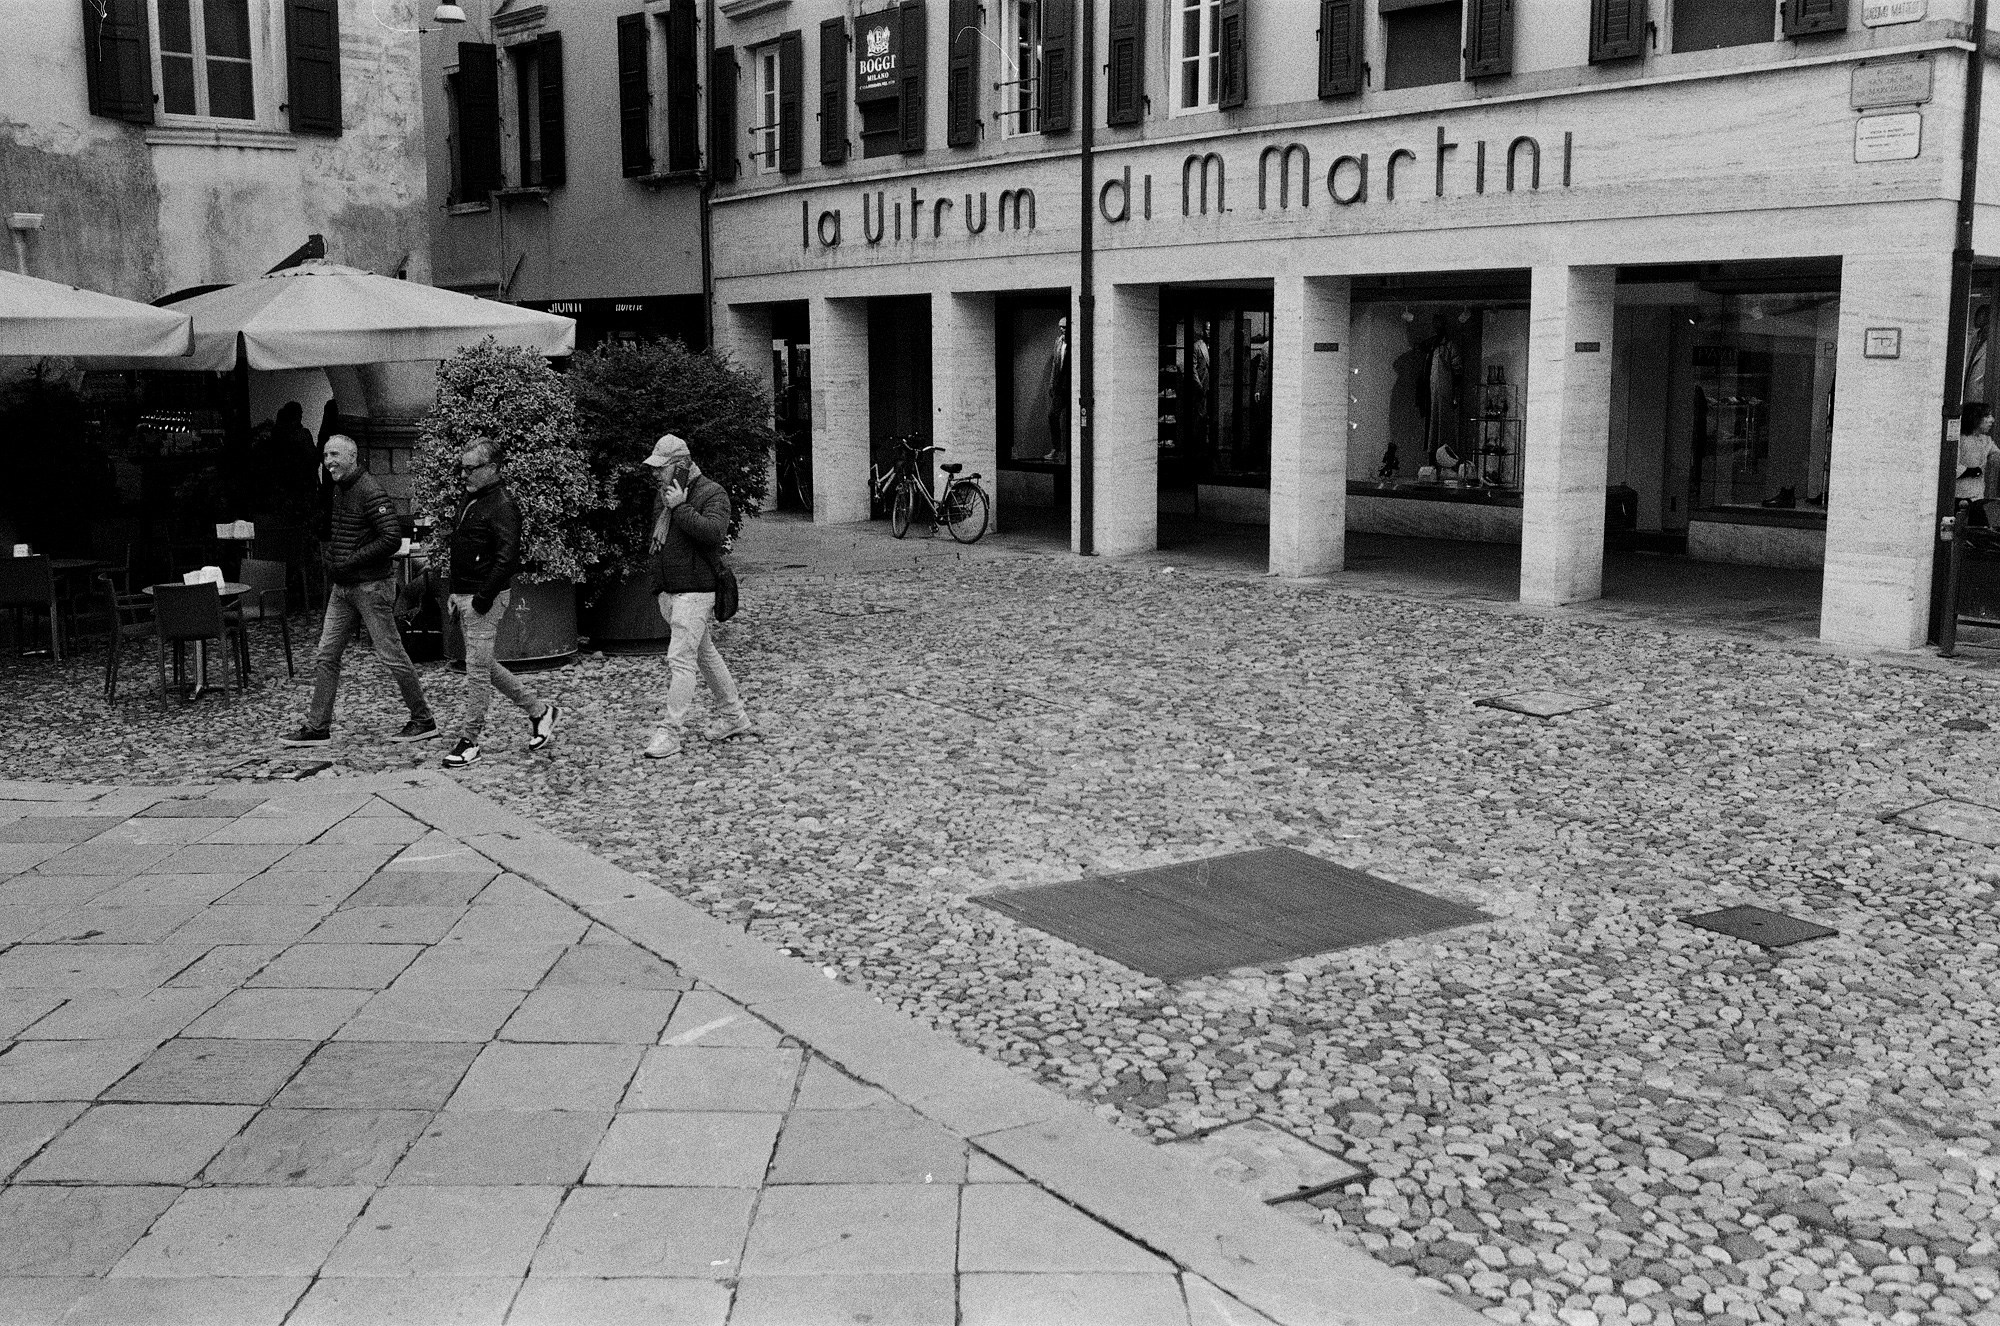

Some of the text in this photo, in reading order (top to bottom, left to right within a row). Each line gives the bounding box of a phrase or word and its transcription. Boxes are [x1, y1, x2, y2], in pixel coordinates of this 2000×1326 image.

[860, 54, 896, 75] BOGGI
[867, 71, 889, 81] MILANO
[803, 201, 840, 248] la
[1099, 165, 1151, 222] di
